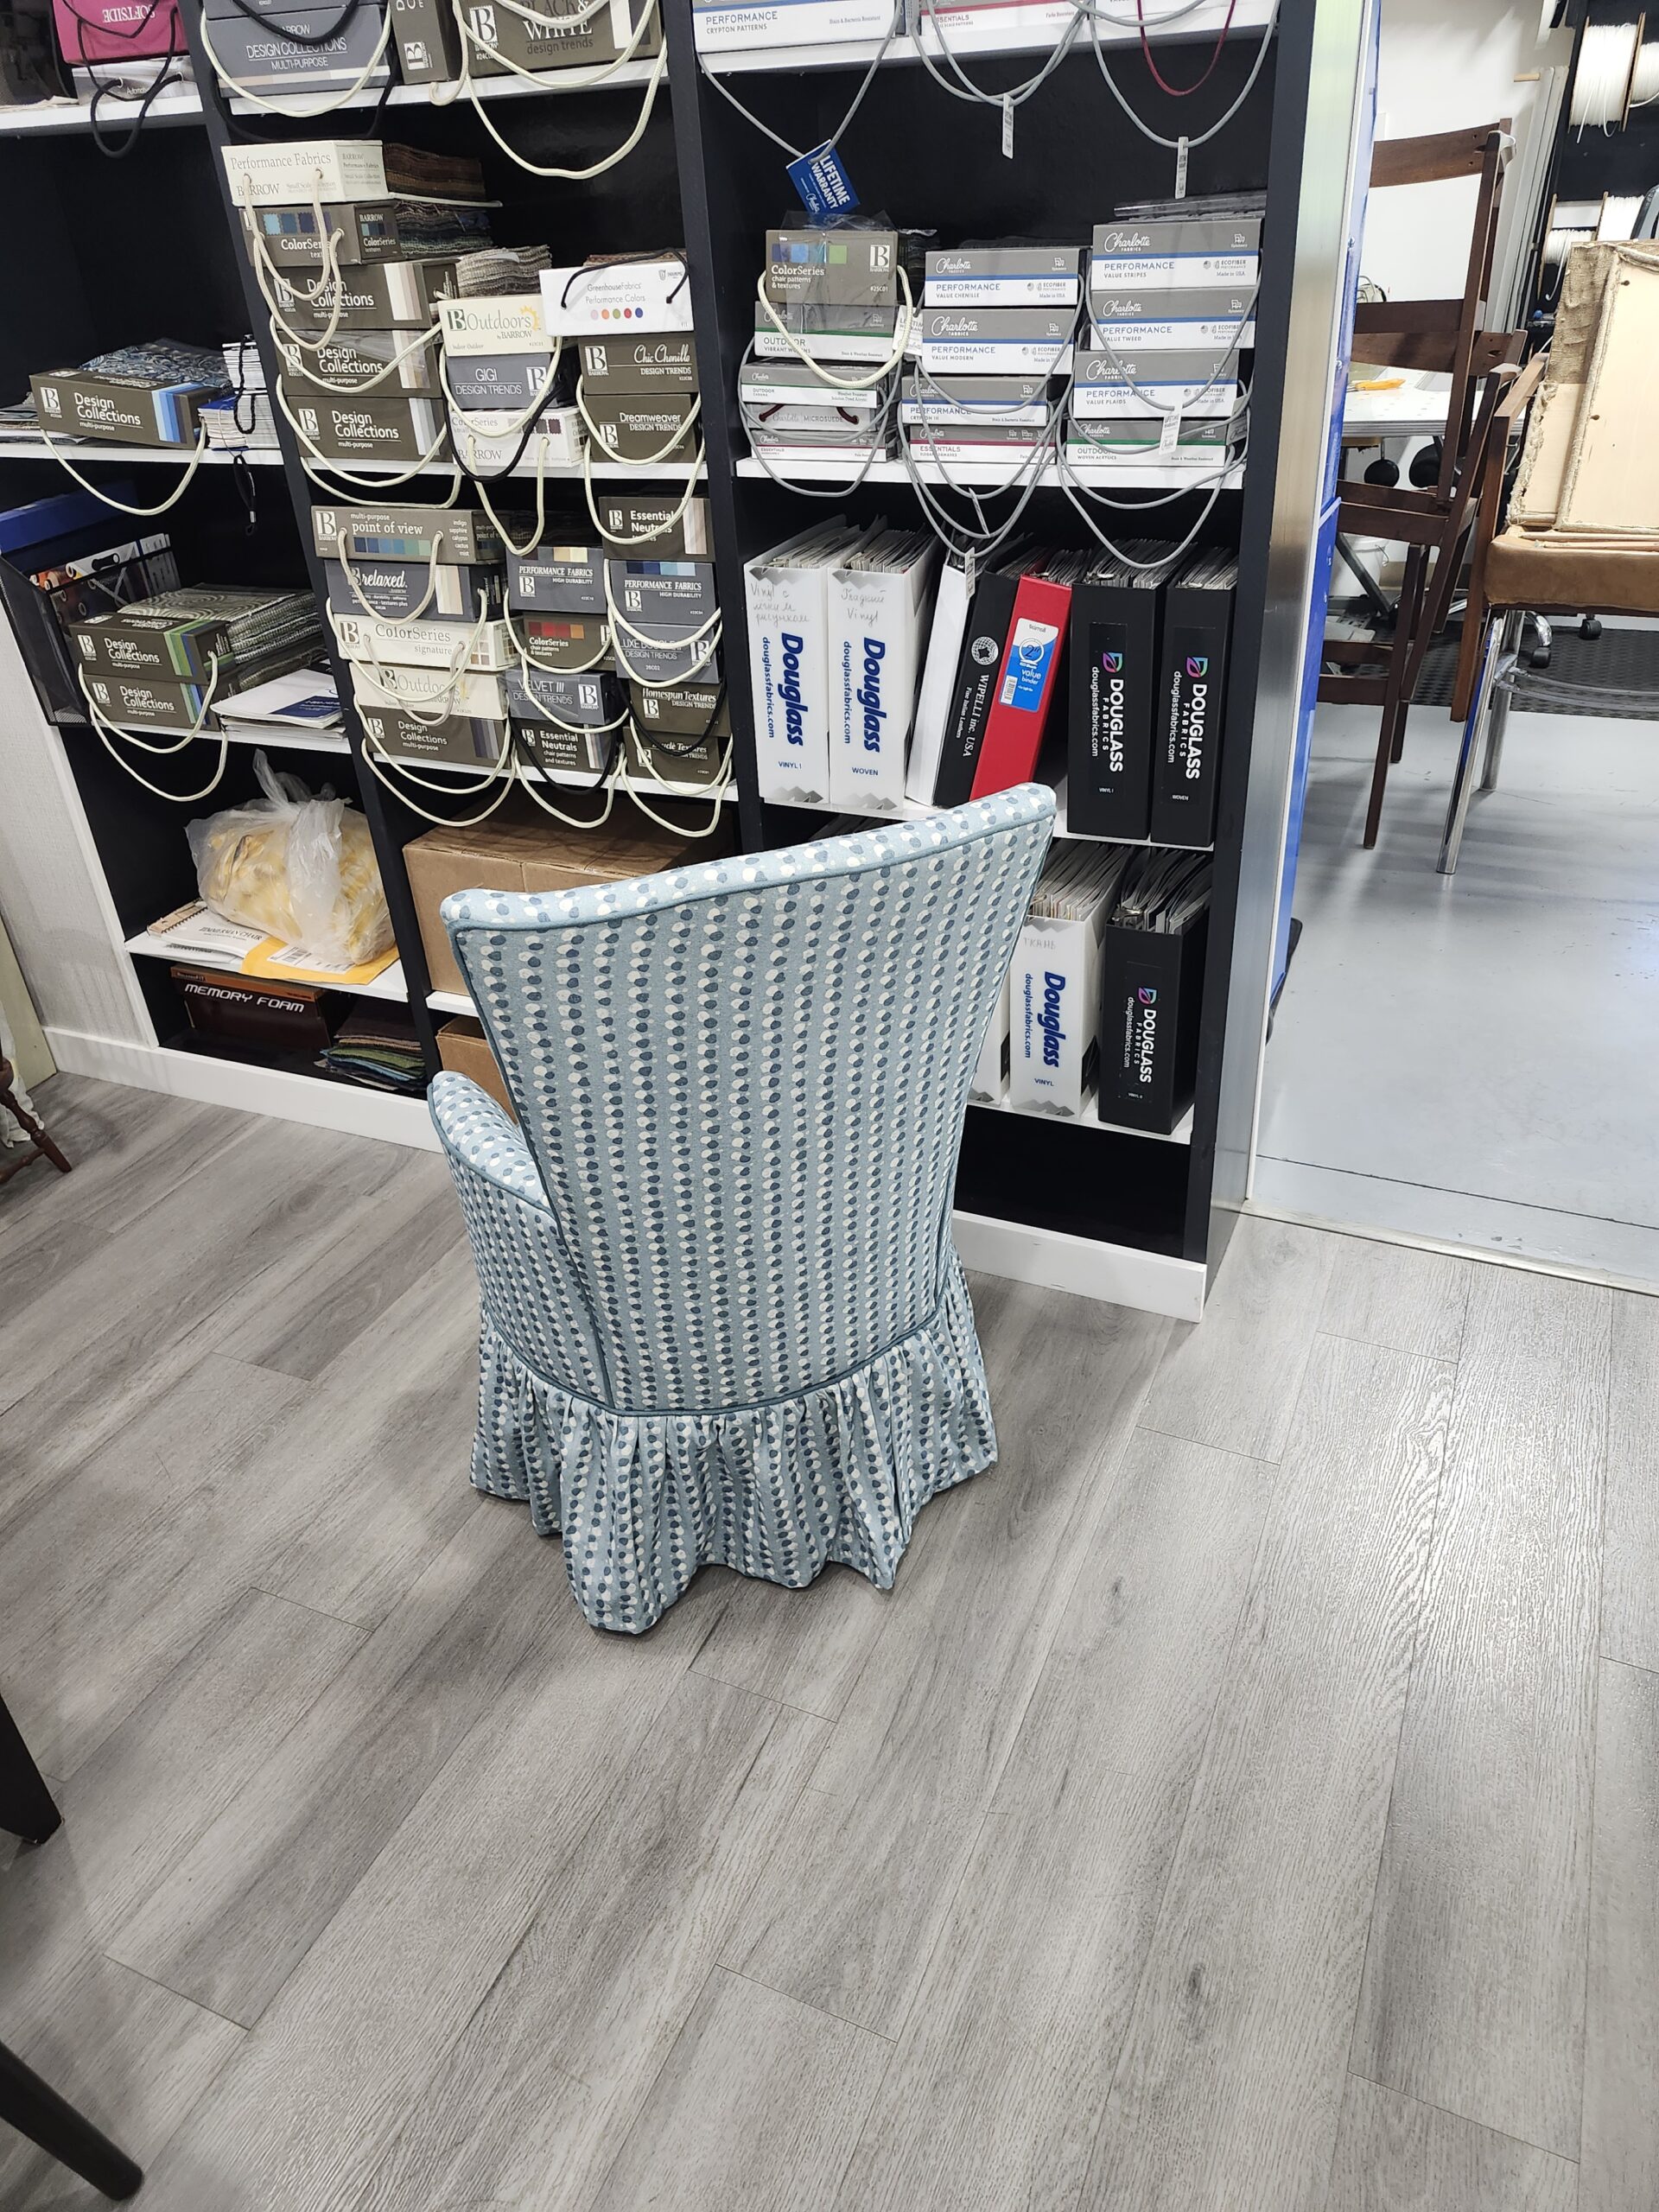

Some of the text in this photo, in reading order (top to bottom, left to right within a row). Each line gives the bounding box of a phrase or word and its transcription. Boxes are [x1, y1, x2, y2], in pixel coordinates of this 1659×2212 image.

[706, 10, 778, 25] PERFORMANCE
[706, 23, 767, 35] CRYPTON PATTERNS
[246, 43, 282, 59] DESIGN
[526, 37, 594, 55] design trends
[270, 57, 329, 70] MULTI-PURPOSE
[231, 152, 332, 170] Performance Fabrics
[811, 162, 839, 209] WARRANTY
[819, 155, 850, 206] LIFETIME
[237, 183, 280, 197] BRROW
[359, 213, 385, 222] BARROW
[363, 237, 397, 248] ColorSeries
[1104, 232, 1152, 252] Charlotte
[772, 264, 825, 276] ColorSeries
[936, 257, 972, 274] Charlotte
[1104, 261, 1175, 270] PERFORMANCE
[936, 283, 1001, 291] PERFORMANCE
[309, 294, 374, 308] Collctions
[586, 294, 645, 304] Performance Colors
[1103, 300, 1142, 317] Charlotte
[467, 308, 531, 331] Outdoors
[931, 315, 979, 336] Charlotte
[500, 330, 532, 340] BARROW
[1103, 326, 1173, 334] PERFORMANCE
[764, 337, 806, 346] OUTDOR
[317, 347, 357, 362] Design
[633, 343, 690, 363] Chic Chenille
[931, 346, 995, 354] PERFORMANCE
[319, 359, 384, 373] Collections
[1086, 359, 1137, 381] Charotte
[475, 368, 498, 381] GIGI
[454, 385, 487, 395] DESIGN
[487, 385, 522, 394] TRENDS
[74, 392, 115, 411] Design
[77, 405, 141, 425] Collections
[332, 410, 372, 428] Design
[620, 412, 681, 423] Dreamweaver
[772, 412, 799, 423] Charlotte
[79, 421, 115, 431] multi-purpose
[334, 424, 399, 439] Collections
[1077, 423, 1111, 437] Charlotte
[630, 510, 675, 521] Essential
[352, 521, 423, 536] point of view
[361, 569, 409, 588] relaxed.
[518, 565, 594, 577] PERFORMANCE FABRICS
[624, 580, 702, 591] PERFORMANCE FABRICS
[750, 582, 775, 601] Vinyl
[847, 607, 879, 628] Vinyl
[375, 624, 451, 642] ColorSeries
[104, 637, 137, 652] Design
[529, 637, 569, 647] ColorSeries
[108, 648, 160, 663] Collections
[414, 645, 452, 656] signature
[625, 650, 677, 660] DESIGN TRENDS
[1021, 668, 1042, 679] value
[556, 682, 565, 693] III
[762, 636, 774, 739] douglassfabrics.com
[1021, 677, 1039, 686] binder
[119, 685, 153, 701] Design
[642, 688, 716, 702] Homespun Textures
[777, 632, 809, 747] Douglass
[842, 640, 852, 745] douglassfabrics.com
[856, 636, 887, 753] Douglass
[963, 686, 973, 699] Fine
[124, 696, 175, 711] Collections
[543, 695, 573, 705] TRENDS
[963, 674, 990, 757] WIPELLI inc. USA
[1090, 666, 1101, 758] douglassfabrics.com
[1167, 671, 1182, 764] douglassfabrics.com
[397, 721, 428, 734] Design
[1109, 678, 1124, 772] DOUGLASS
[1179, 702, 1190, 758] FABRICS
[1185, 683, 1208, 780] DOUGLASS
[400, 731, 448, 745] Collections
[539, 730, 579, 742] Essential
[402, 741, 439, 751] multi-purpose
[541, 740, 578, 752] Neutrals
[778, 760, 798, 769] VINYL
[851, 766, 880, 776] WOVEN
[184, 982, 305, 1013] MEMORY FOAM
[1023, 973, 1033, 1059] douglassfabrics.com
[1036, 970, 1066, 1068] Douglass
[1123, 996, 1135, 1069] douglassfabrics.com
[1134, 1022, 1142, 1065] FABRICS
[1140, 1008, 1157, 1084] DOUGLASS
[1033, 1077, 1054, 1087] VINYL
